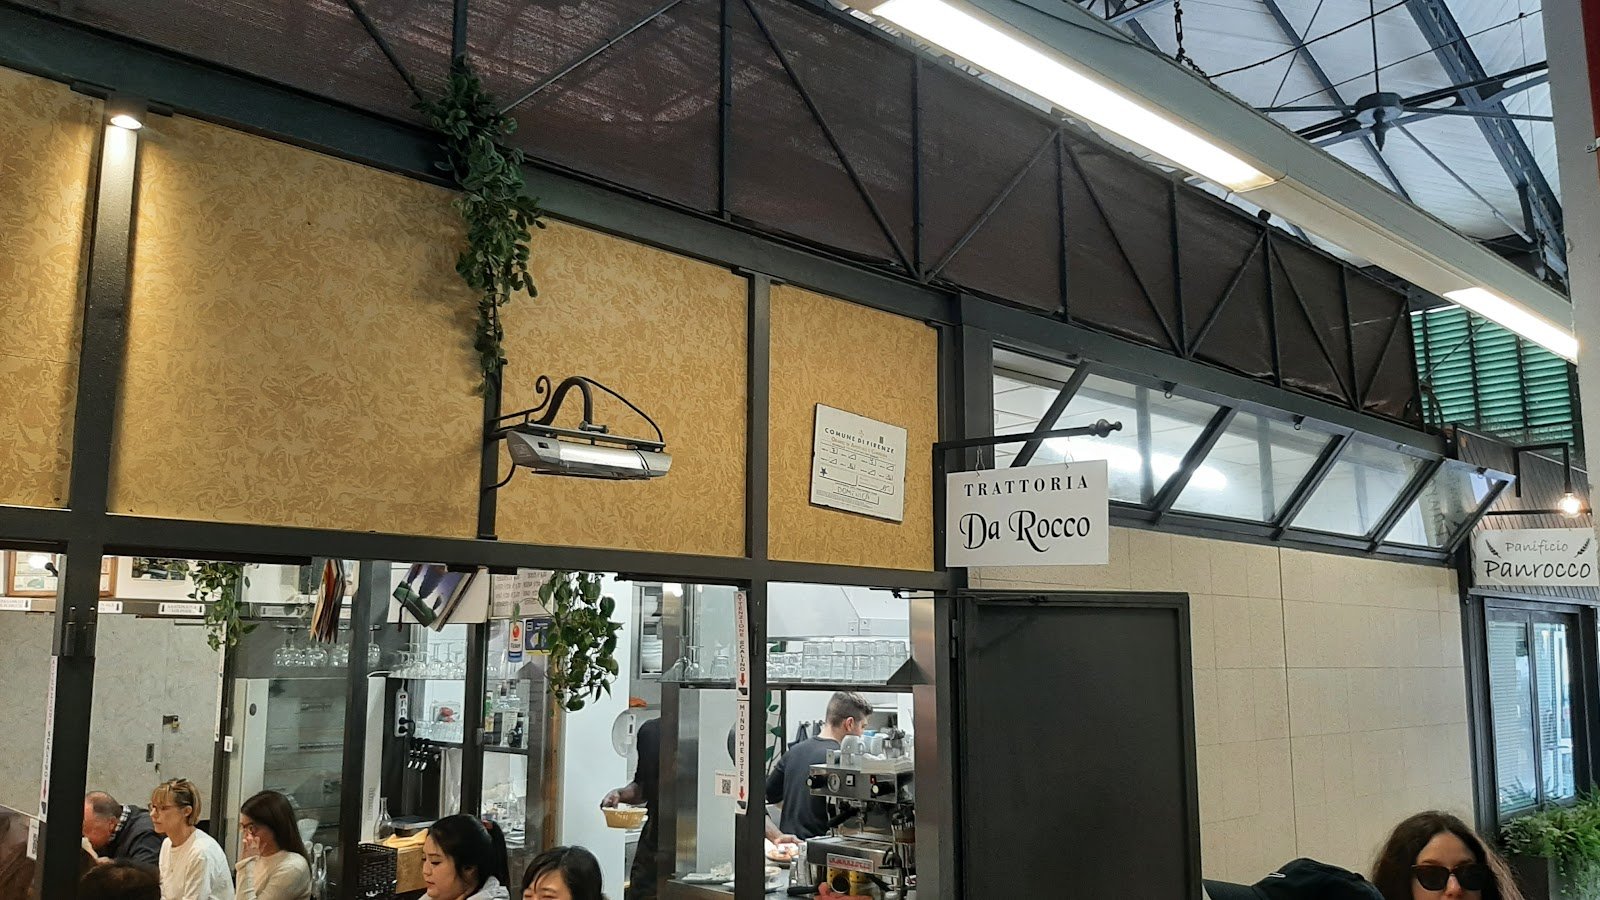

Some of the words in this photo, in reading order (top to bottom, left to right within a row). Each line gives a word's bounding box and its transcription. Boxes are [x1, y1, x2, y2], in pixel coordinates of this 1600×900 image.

[825, 428, 855, 441] COMUNE
[866, 441, 895, 453] FIRENZE
[964, 475, 1088, 496] TRATTORIA
[959, 513, 1000, 549] Da
[1008, 510, 1090, 552] Rocco
[1505, 540, 1568, 555] Panificio
[1483, 560, 1591, 578] Panrocco
